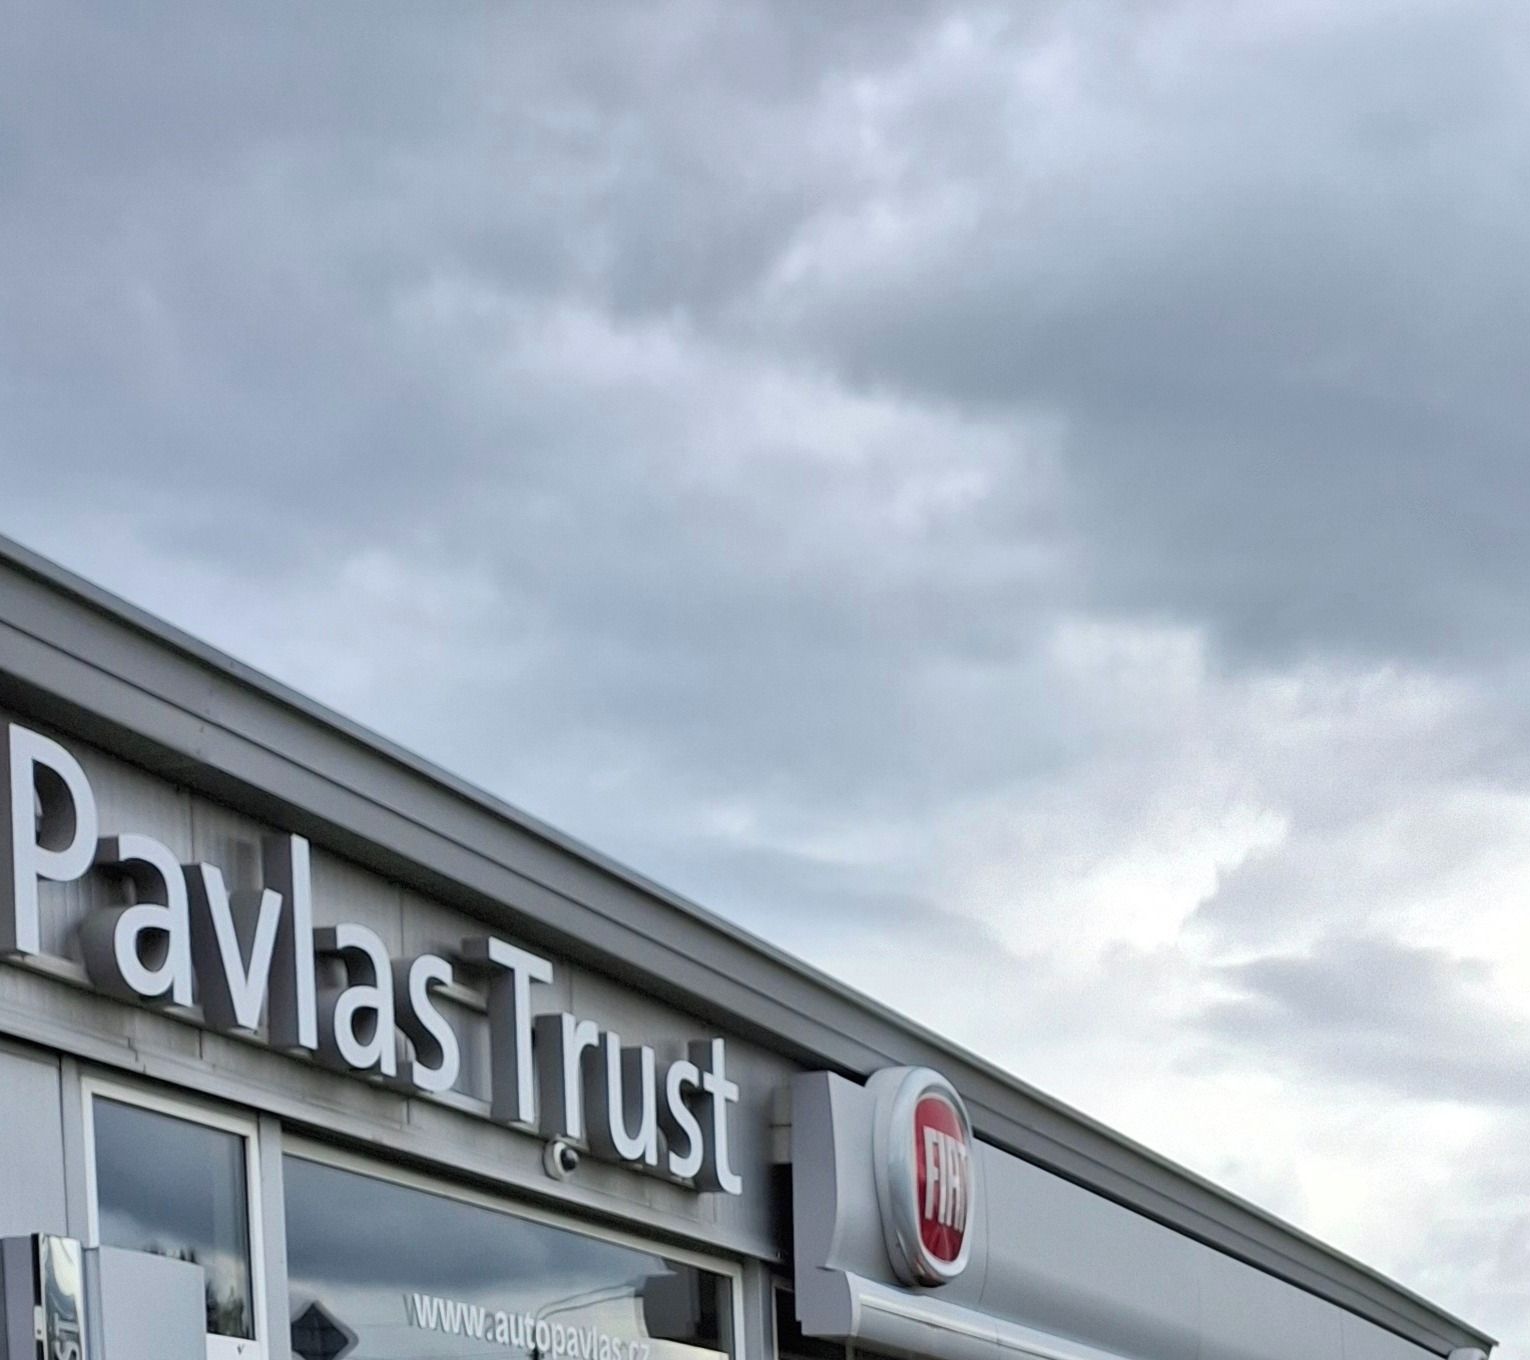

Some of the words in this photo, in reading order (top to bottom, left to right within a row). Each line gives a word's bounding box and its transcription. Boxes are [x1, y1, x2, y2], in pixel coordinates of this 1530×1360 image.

[8, 722, 461, 1094] Pavlas
[486, 935, 743, 1195] Trust
[922, 1124, 968, 1234] FIAT
